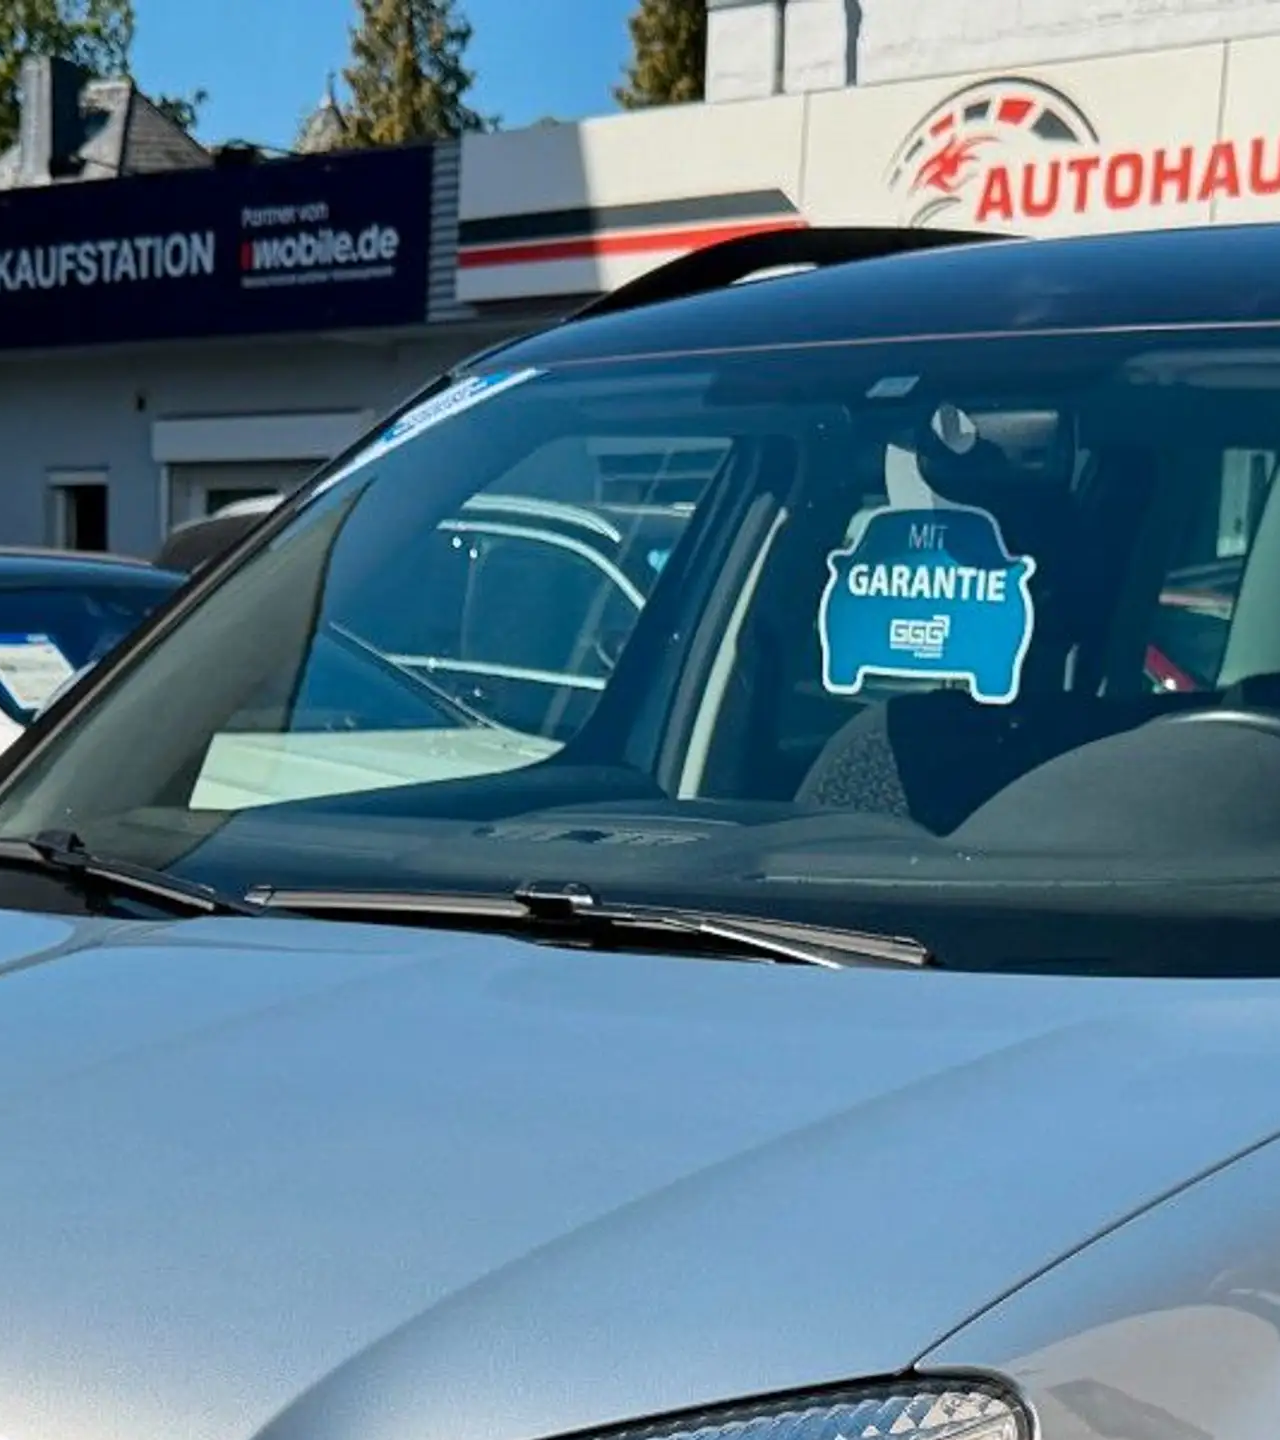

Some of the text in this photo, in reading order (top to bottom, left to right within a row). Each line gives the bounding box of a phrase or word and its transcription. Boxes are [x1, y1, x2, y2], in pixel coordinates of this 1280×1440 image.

[240, 223, 400, 271] mobile.de
[908, 523, 949, 550] MIT
[847, 563, 1008, 602] GARANTIE
